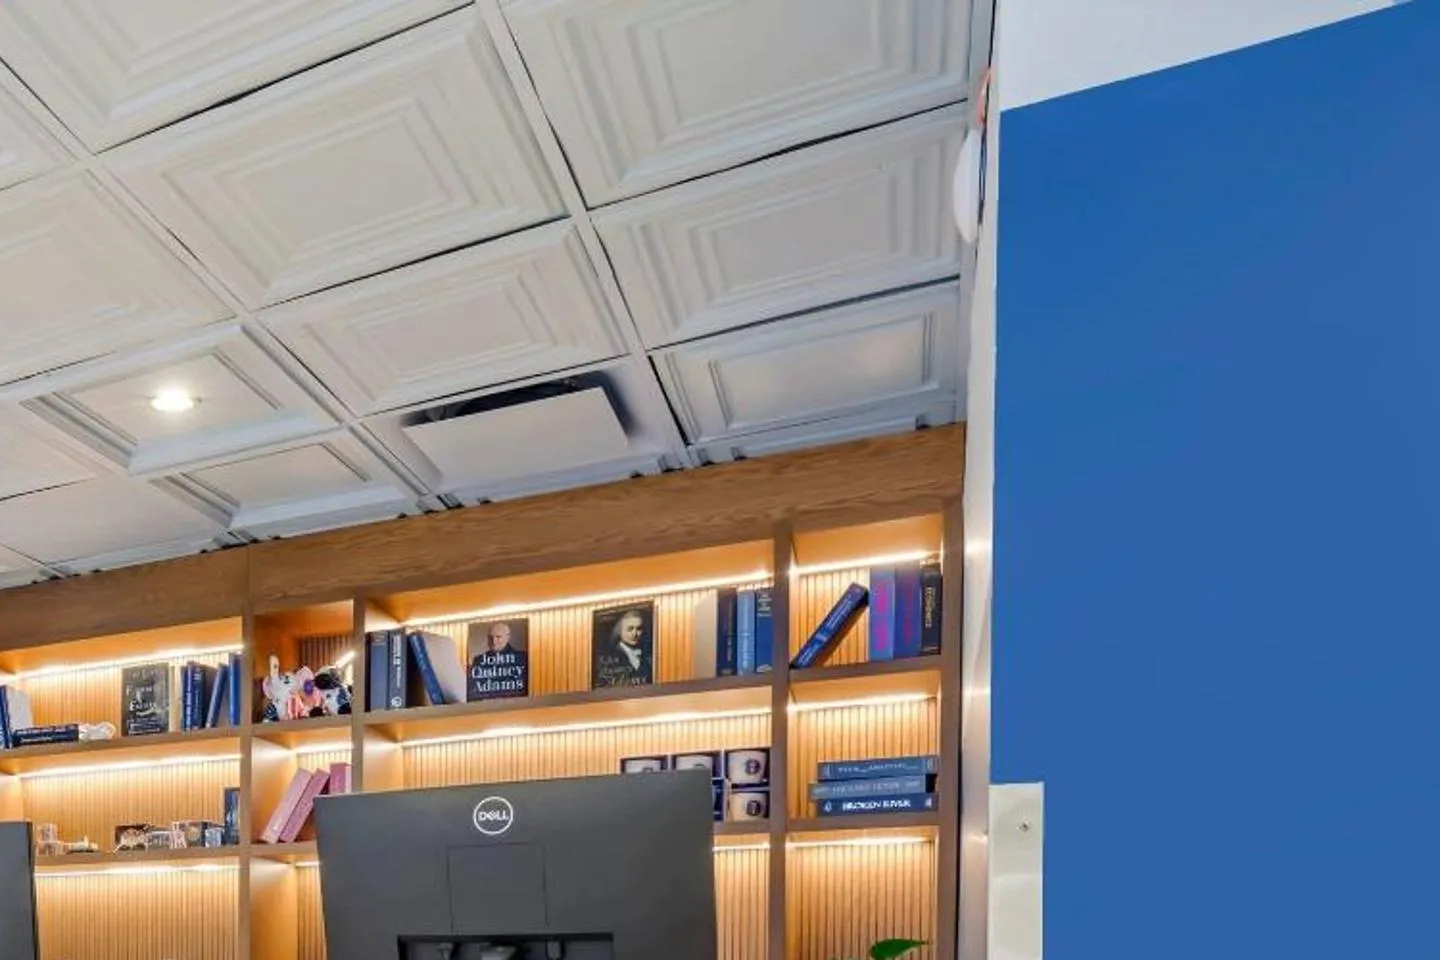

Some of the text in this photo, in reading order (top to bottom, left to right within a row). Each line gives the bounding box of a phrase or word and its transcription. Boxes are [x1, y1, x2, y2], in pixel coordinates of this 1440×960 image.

[479, 651, 516, 665] John
[471, 664, 525, 679] Quincy
[474, 677, 524, 692] Adams
[477, 810, 510, 821] DELL
